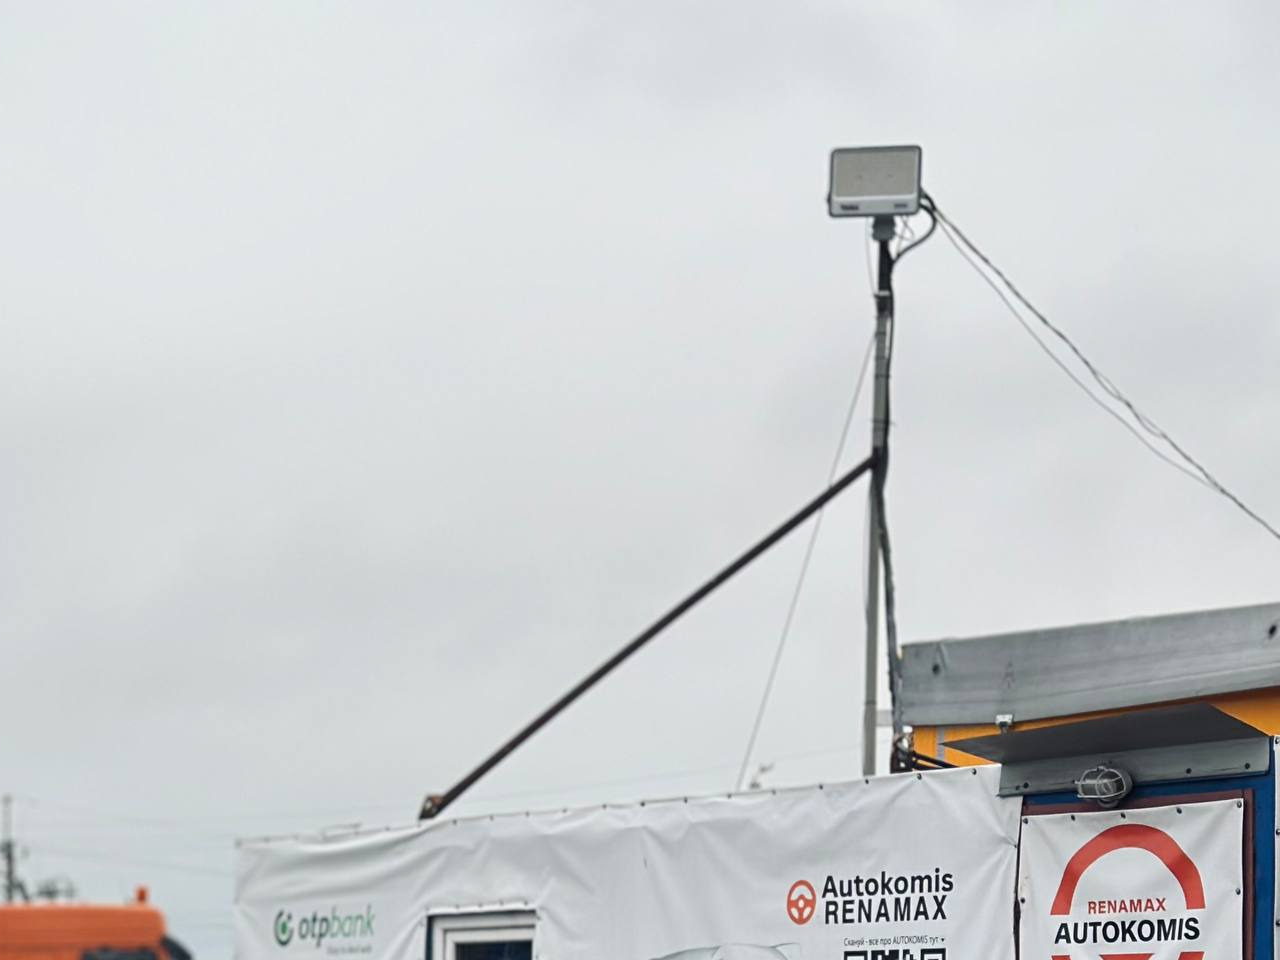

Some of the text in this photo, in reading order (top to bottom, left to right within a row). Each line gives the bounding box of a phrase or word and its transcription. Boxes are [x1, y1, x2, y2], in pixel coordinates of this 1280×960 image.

[822, 868, 954, 899] Autokomis
[824, 895, 948, 925] RENAMAX
[1088, 897, 1166, 915] RENAMAX
[1054, 917, 1201, 944] AUTOKOMIS
